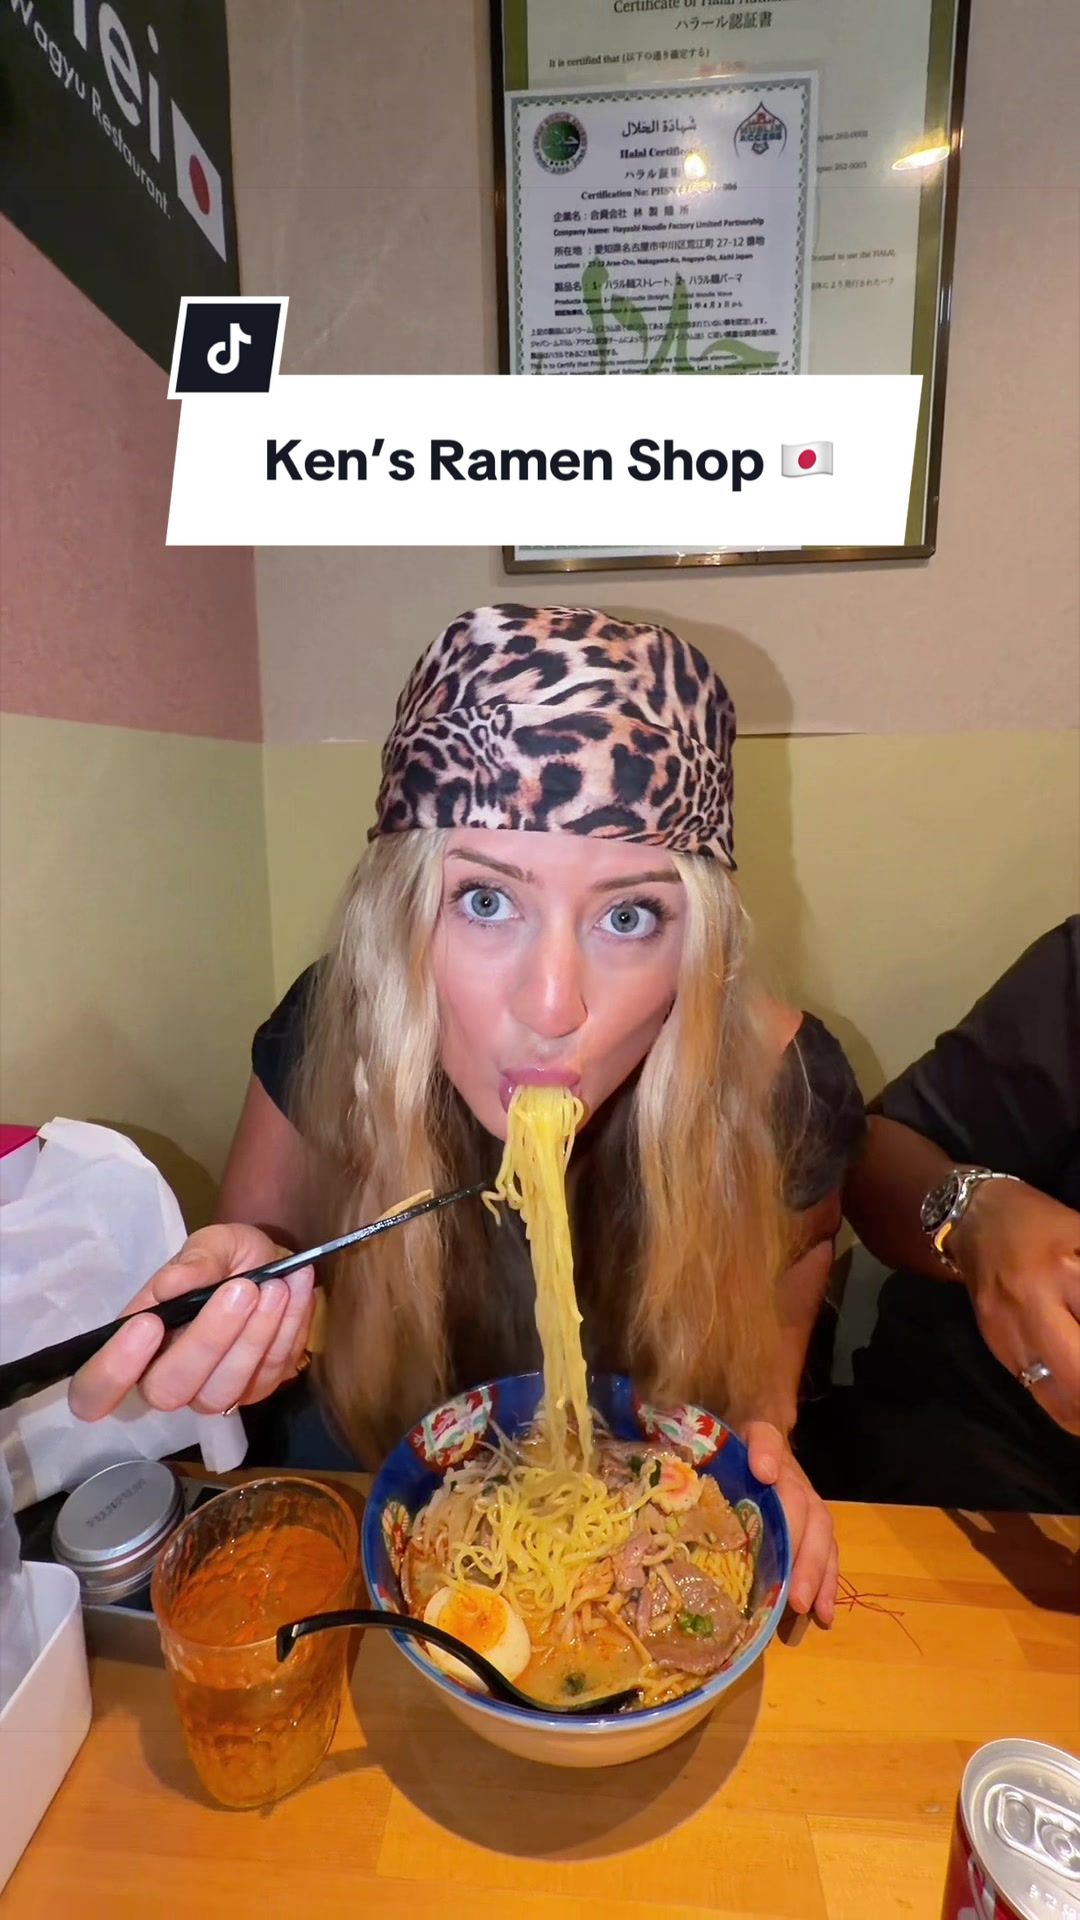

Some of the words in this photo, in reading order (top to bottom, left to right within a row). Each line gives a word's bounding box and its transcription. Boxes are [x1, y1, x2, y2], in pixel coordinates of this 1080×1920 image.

[613, 0, 680, 14] Certificate
[620, 148, 647, 159] Halal
[581, 189, 632, 200] Certification
[553, 228, 587, 237] Company
